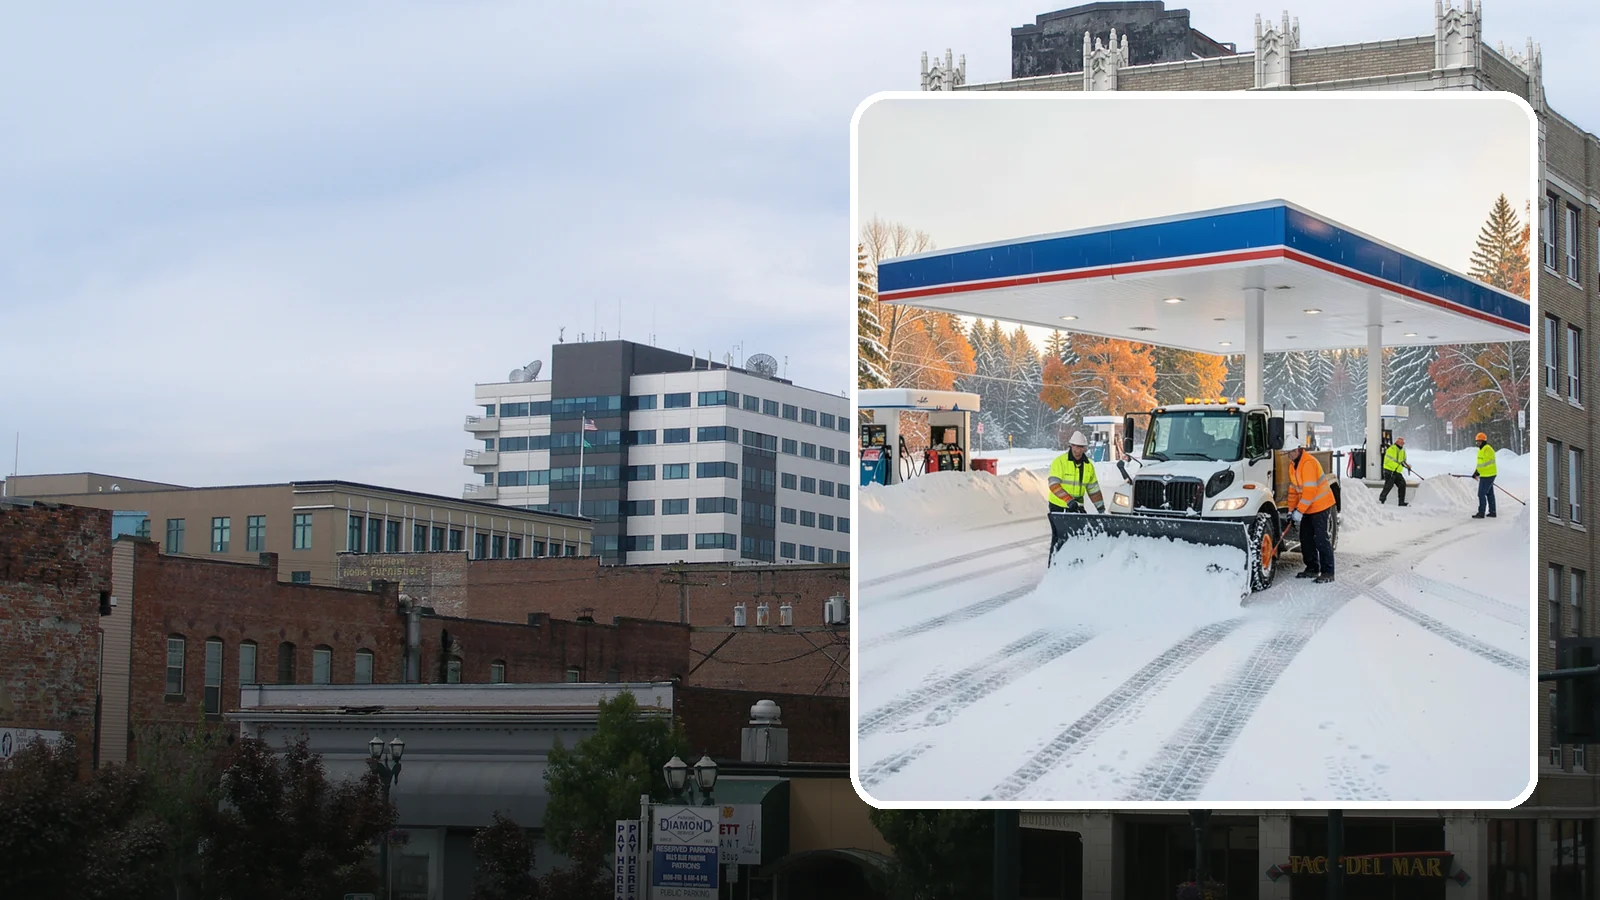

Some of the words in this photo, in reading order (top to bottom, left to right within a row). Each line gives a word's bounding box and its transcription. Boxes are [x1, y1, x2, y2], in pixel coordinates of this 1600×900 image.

[370, 566, 427, 576] Furnishers
[660, 818, 713, 833] DIAMOND
[1022, 815, 1069, 827] BUILDING
[719, 824, 740, 835] ETT
[617, 824, 625, 852] PAY
[628, 824, 637, 852] PAY
[719, 839, 740, 848] ANT
[656, 845, 688, 853] RESERVED
[689, 846, 716, 854] PARKING
[721, 851, 739, 862] Soup
[671, 862, 701, 870] PATRONS
[1290, 855, 1329, 873] TAC
[1346, 856, 1385, 875] DEL
[1392, 858, 1442, 877] MAR
[617, 856, 625, 894] HERE
[628, 856, 636, 893] HERE
[660, 889, 682, 897] PUBLIC
[683, 890, 710, 898] PARKING
